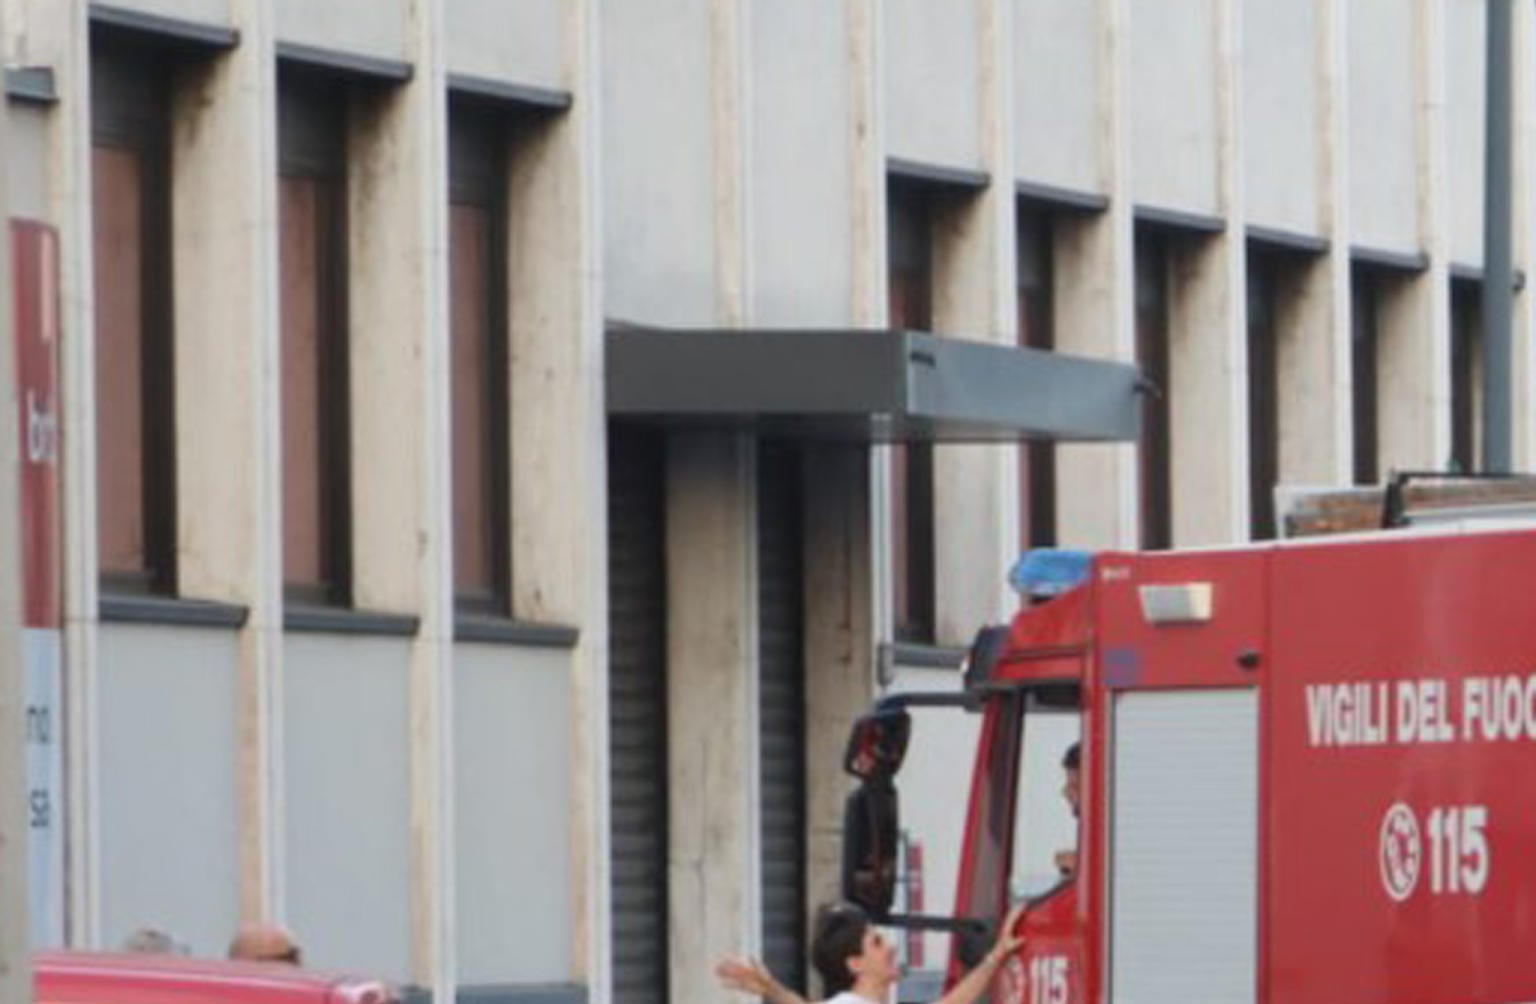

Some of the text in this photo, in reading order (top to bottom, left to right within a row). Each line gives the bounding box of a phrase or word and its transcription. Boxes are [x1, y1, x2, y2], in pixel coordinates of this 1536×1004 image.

[1305, 682, 1388, 747] VIGILI
[1396, 679, 1455, 743] DEL
[1428, 806, 1489, 894] 115
